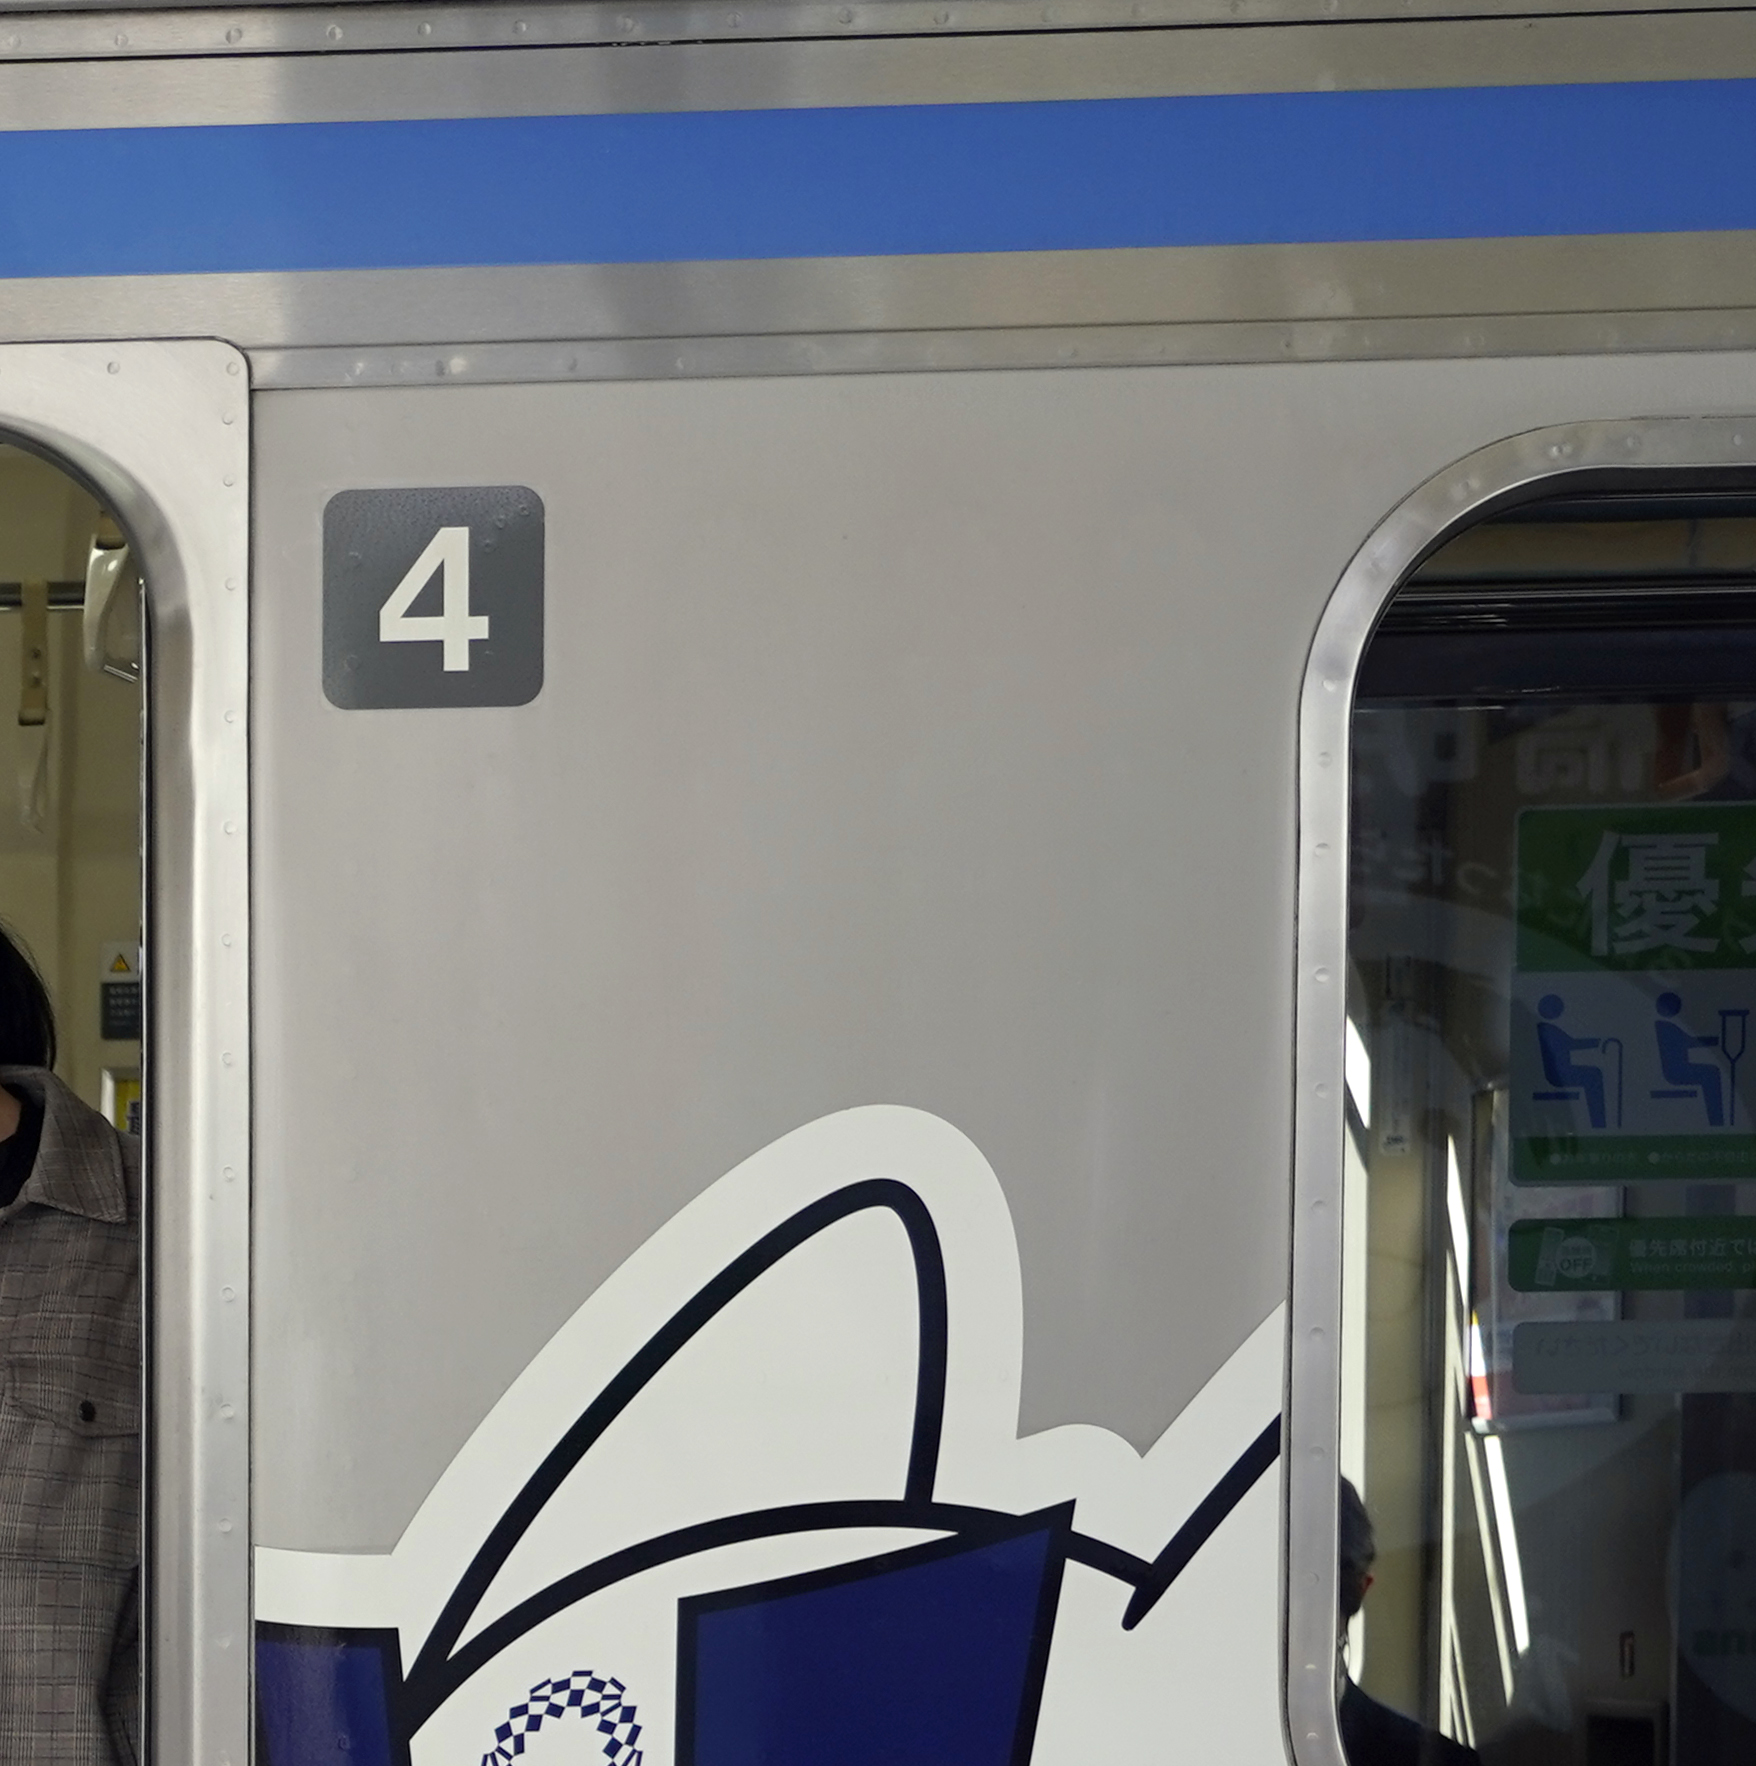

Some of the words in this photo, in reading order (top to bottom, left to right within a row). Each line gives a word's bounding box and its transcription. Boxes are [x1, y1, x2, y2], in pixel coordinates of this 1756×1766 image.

[379, 526, 489, 672] 4
[1575, 830, 1756, 957] 優
[1559, 1257, 1593, 1272] OFF
[1630, 1261, 1670, 1273] When
